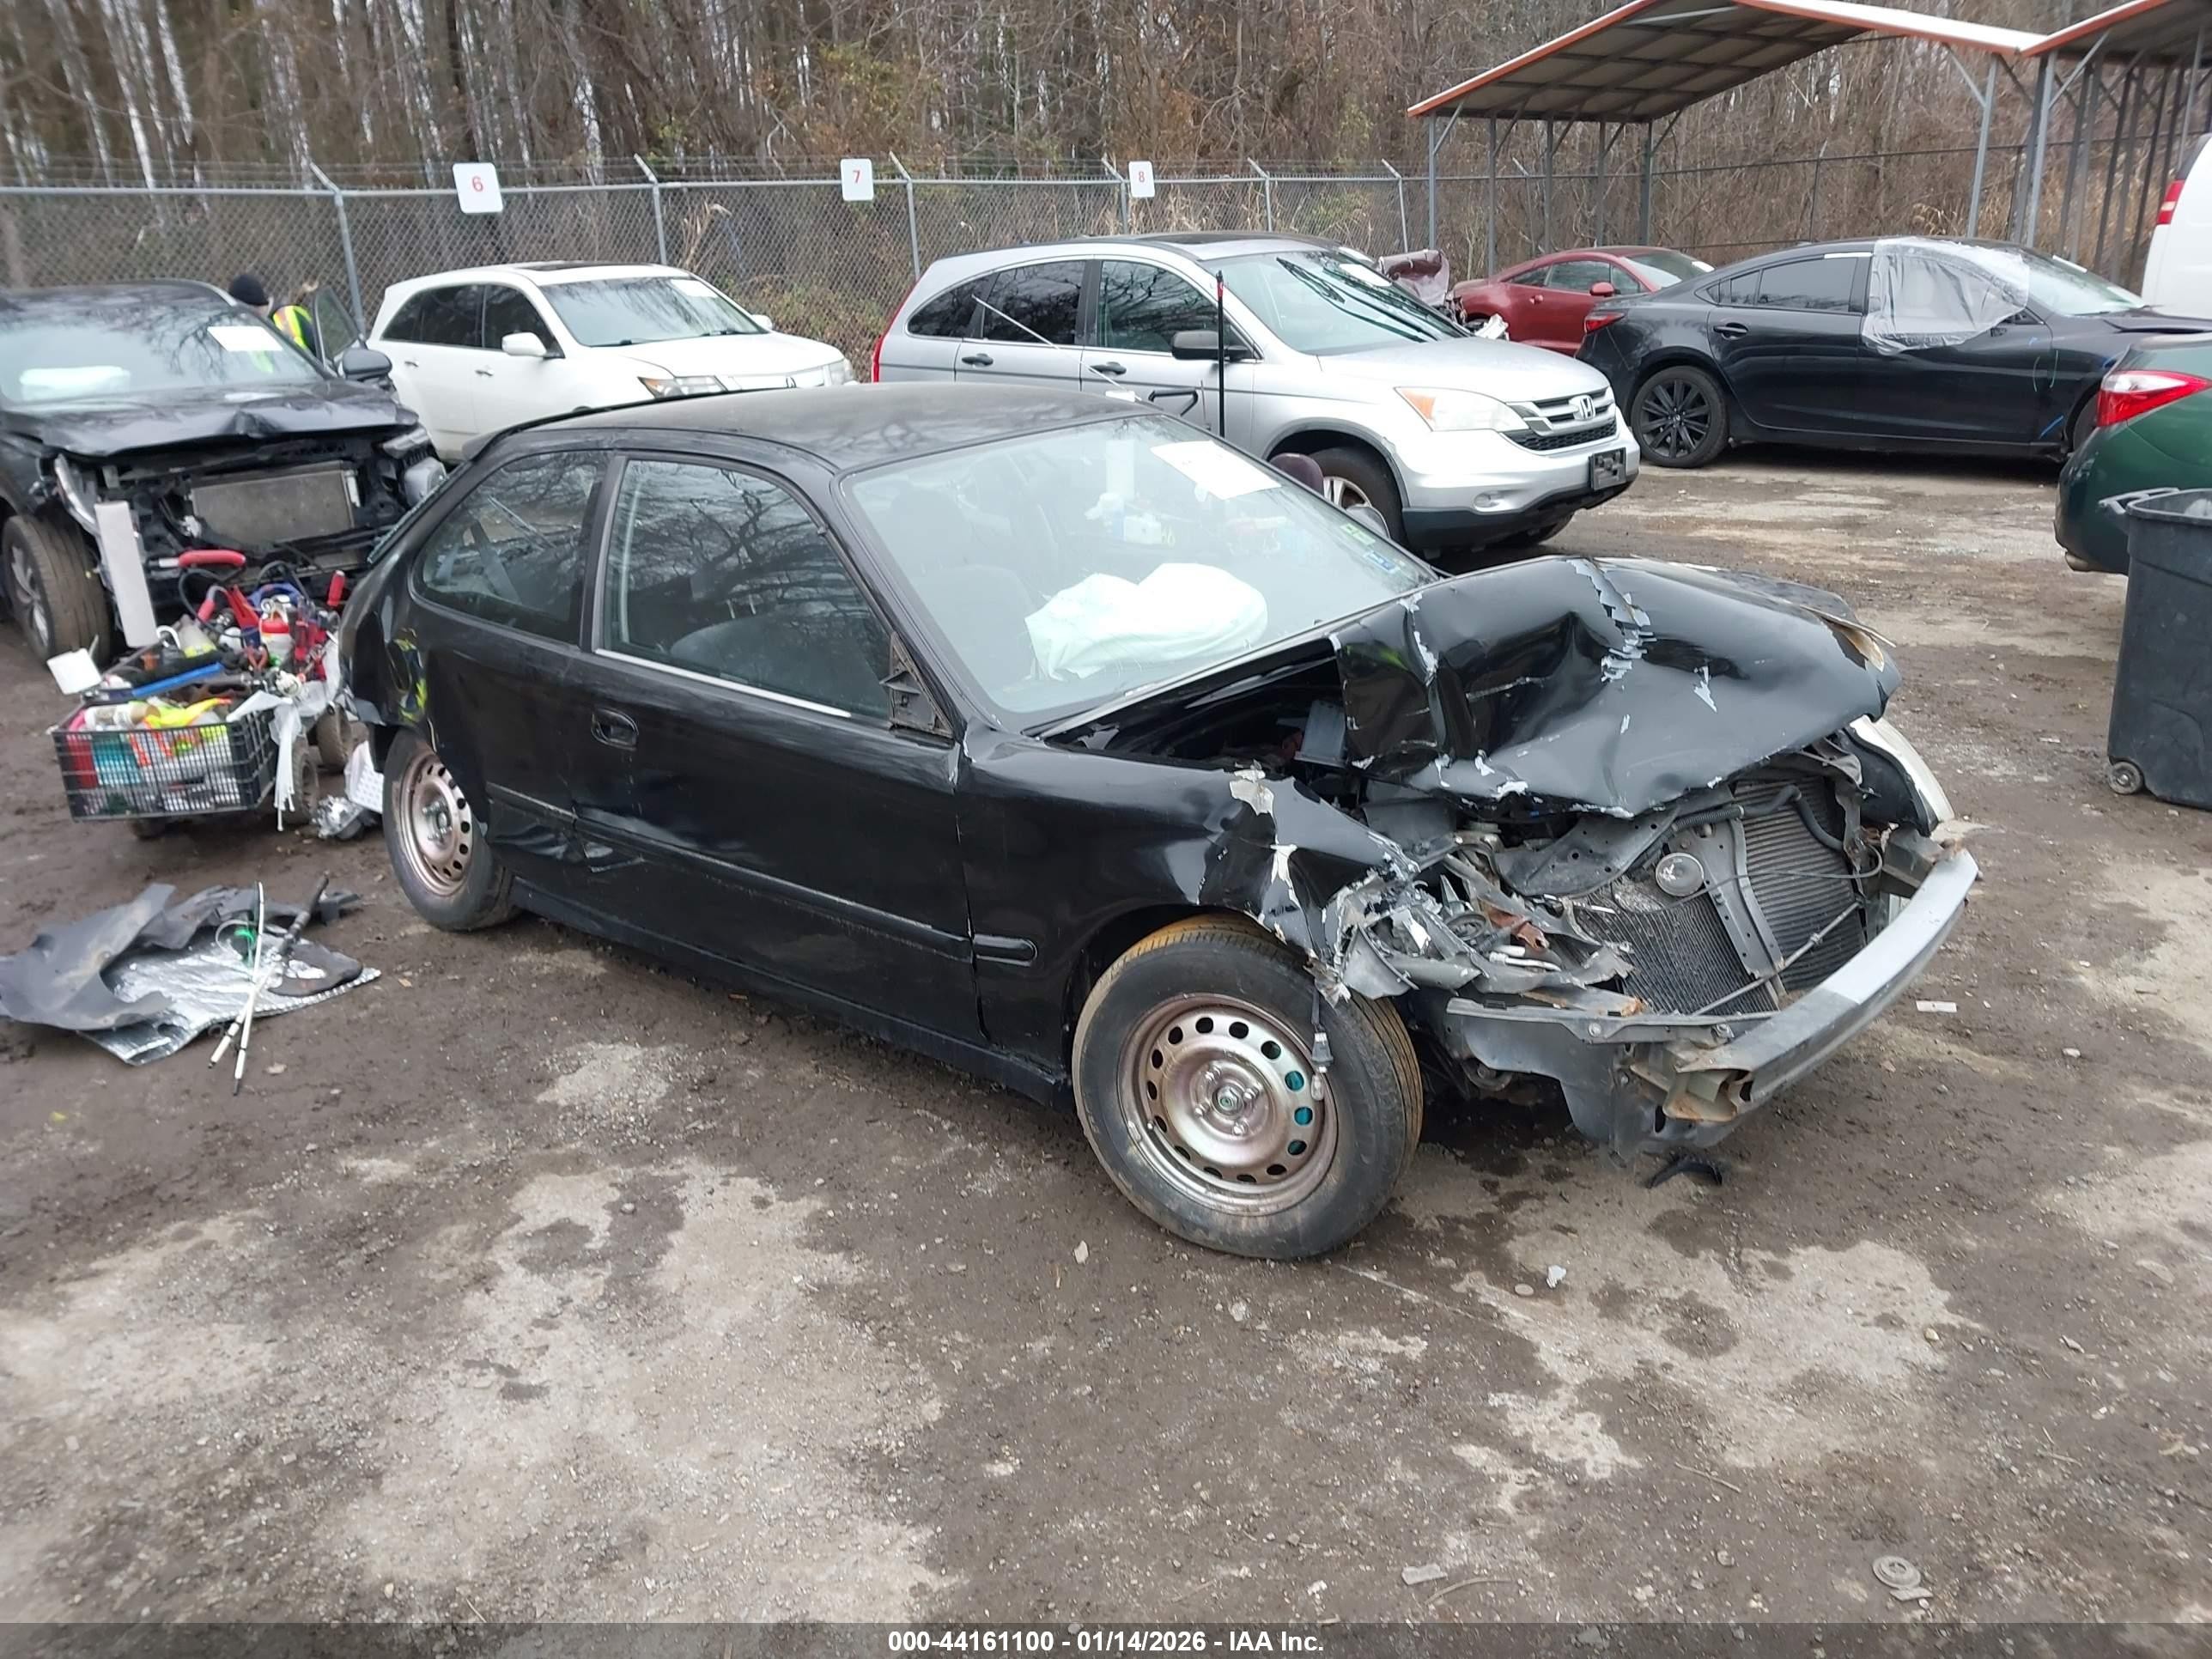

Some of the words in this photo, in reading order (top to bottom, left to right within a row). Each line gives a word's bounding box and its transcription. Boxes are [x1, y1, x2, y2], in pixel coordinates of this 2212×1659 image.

[471, 175, 484, 192] 6
[852, 170, 861, 184] 7
[1138, 171, 1146, 183] 8
